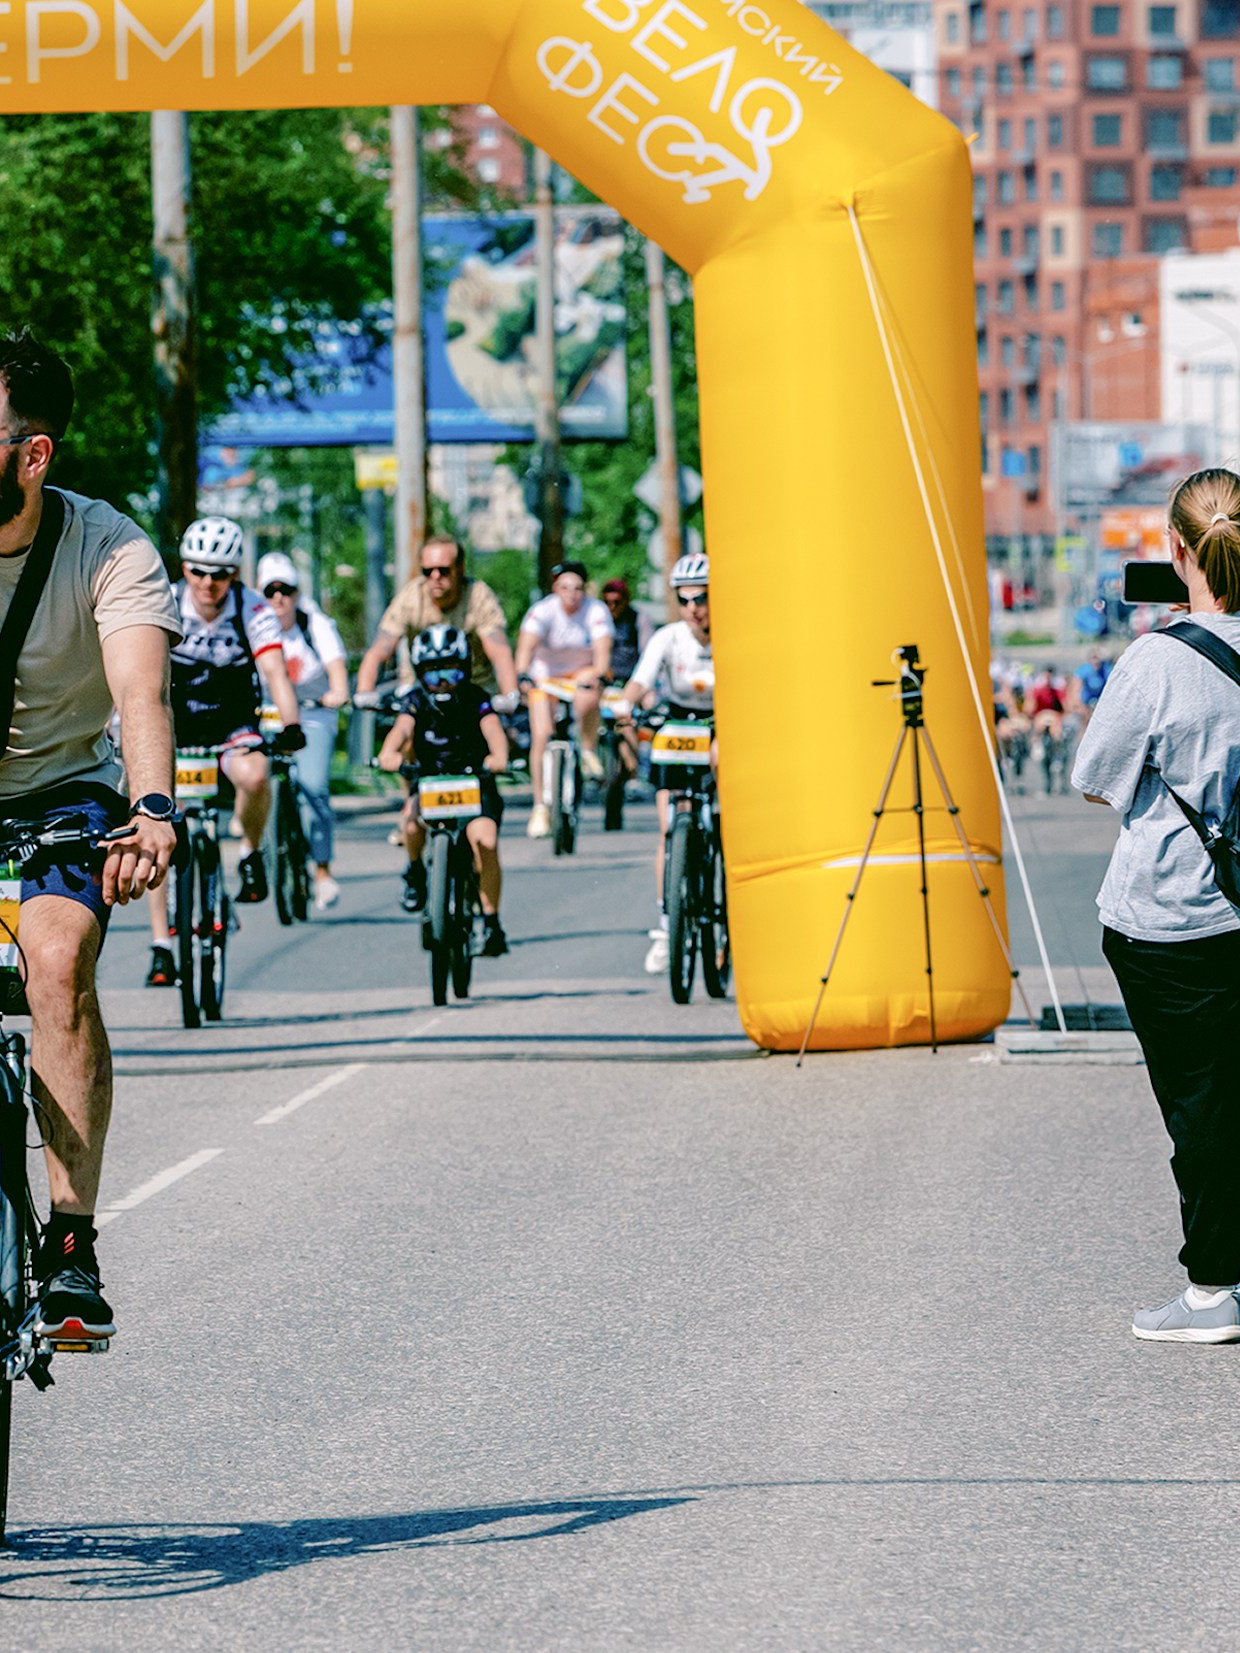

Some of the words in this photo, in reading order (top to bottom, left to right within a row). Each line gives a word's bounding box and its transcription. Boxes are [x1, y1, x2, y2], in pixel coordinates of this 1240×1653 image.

[667, 738, 696, 751] 620
[176, 770, 202, 784] 614
[437, 791, 463, 806] 621
